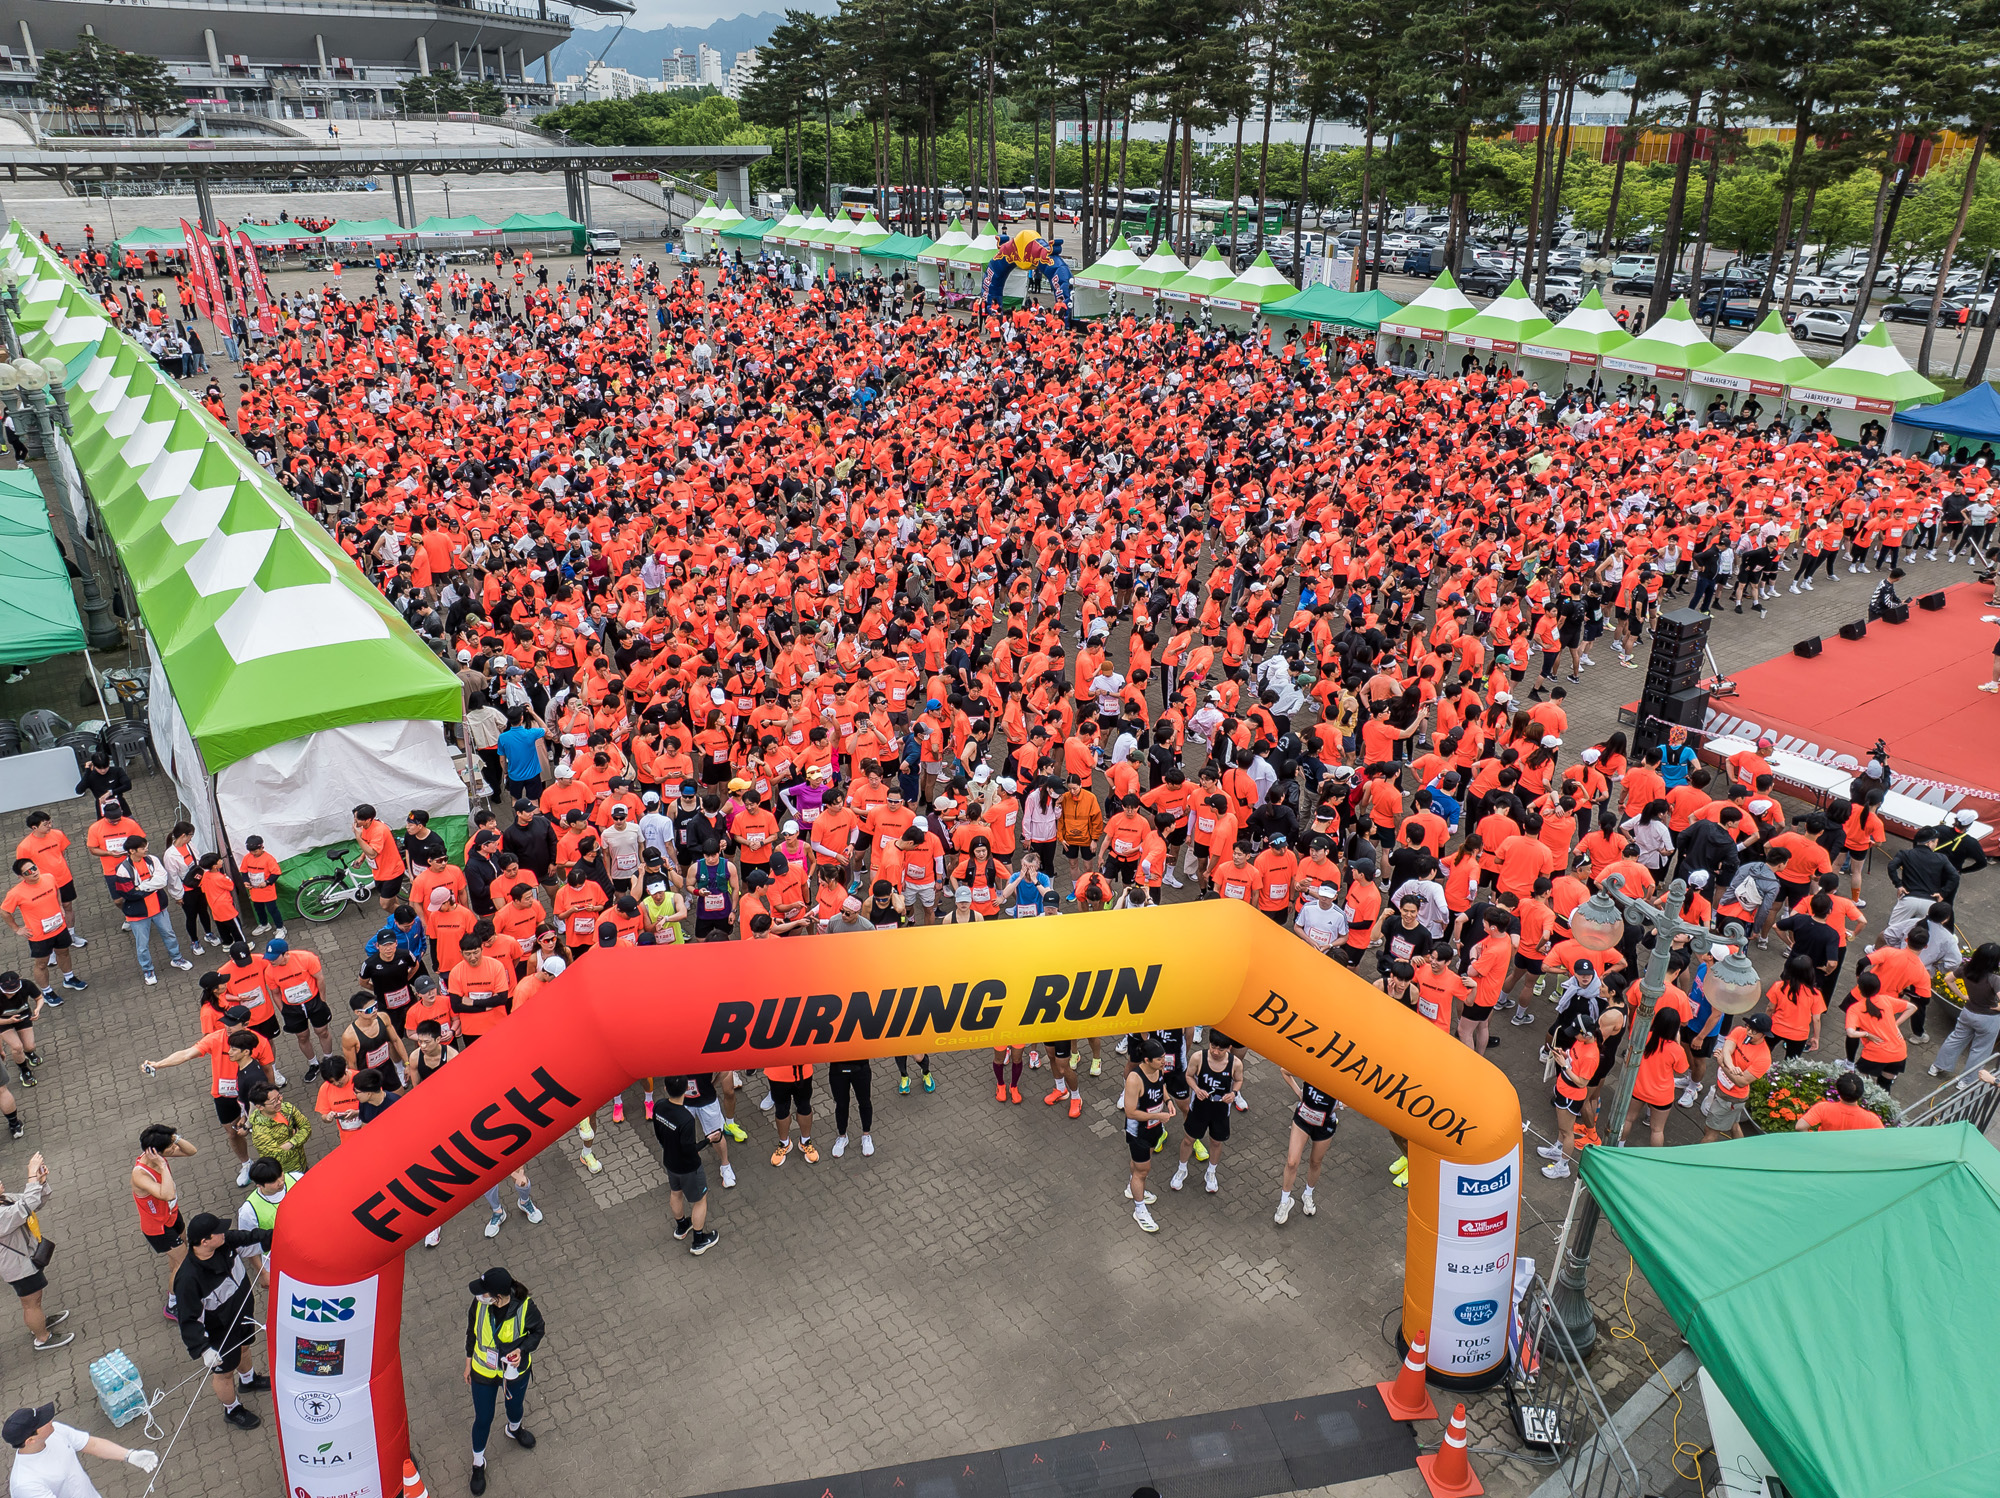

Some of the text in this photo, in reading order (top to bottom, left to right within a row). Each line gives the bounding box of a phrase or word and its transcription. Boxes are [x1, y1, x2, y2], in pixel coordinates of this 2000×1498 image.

[1704, 376, 1738, 387] 사회자대기실
[1804, 392, 1843, 404] 사회자대기실
[1583, 962, 1589, 970] S
[701, 964, 1163, 1054] BURNING RUN
[934, 1032, 994, 1046] Casual
[1078, 1018, 1144, 1032] Festival
[351, 1066, 582, 1243] FINISH
[1462, 1172, 1508, 1194] Maeil
[1476, 1220, 1504, 1232] REDFACE
[1447, 1262, 1496, 1274] 일요신문
[1460, 1308, 1493, 1322] 백산수
[1456, 1336, 1490, 1348] TOUS
[1451, 1350, 1492, 1364] JOURS
[304, 1414, 333, 1422] TANNING
[298, 1452, 352, 1464] CHAI
